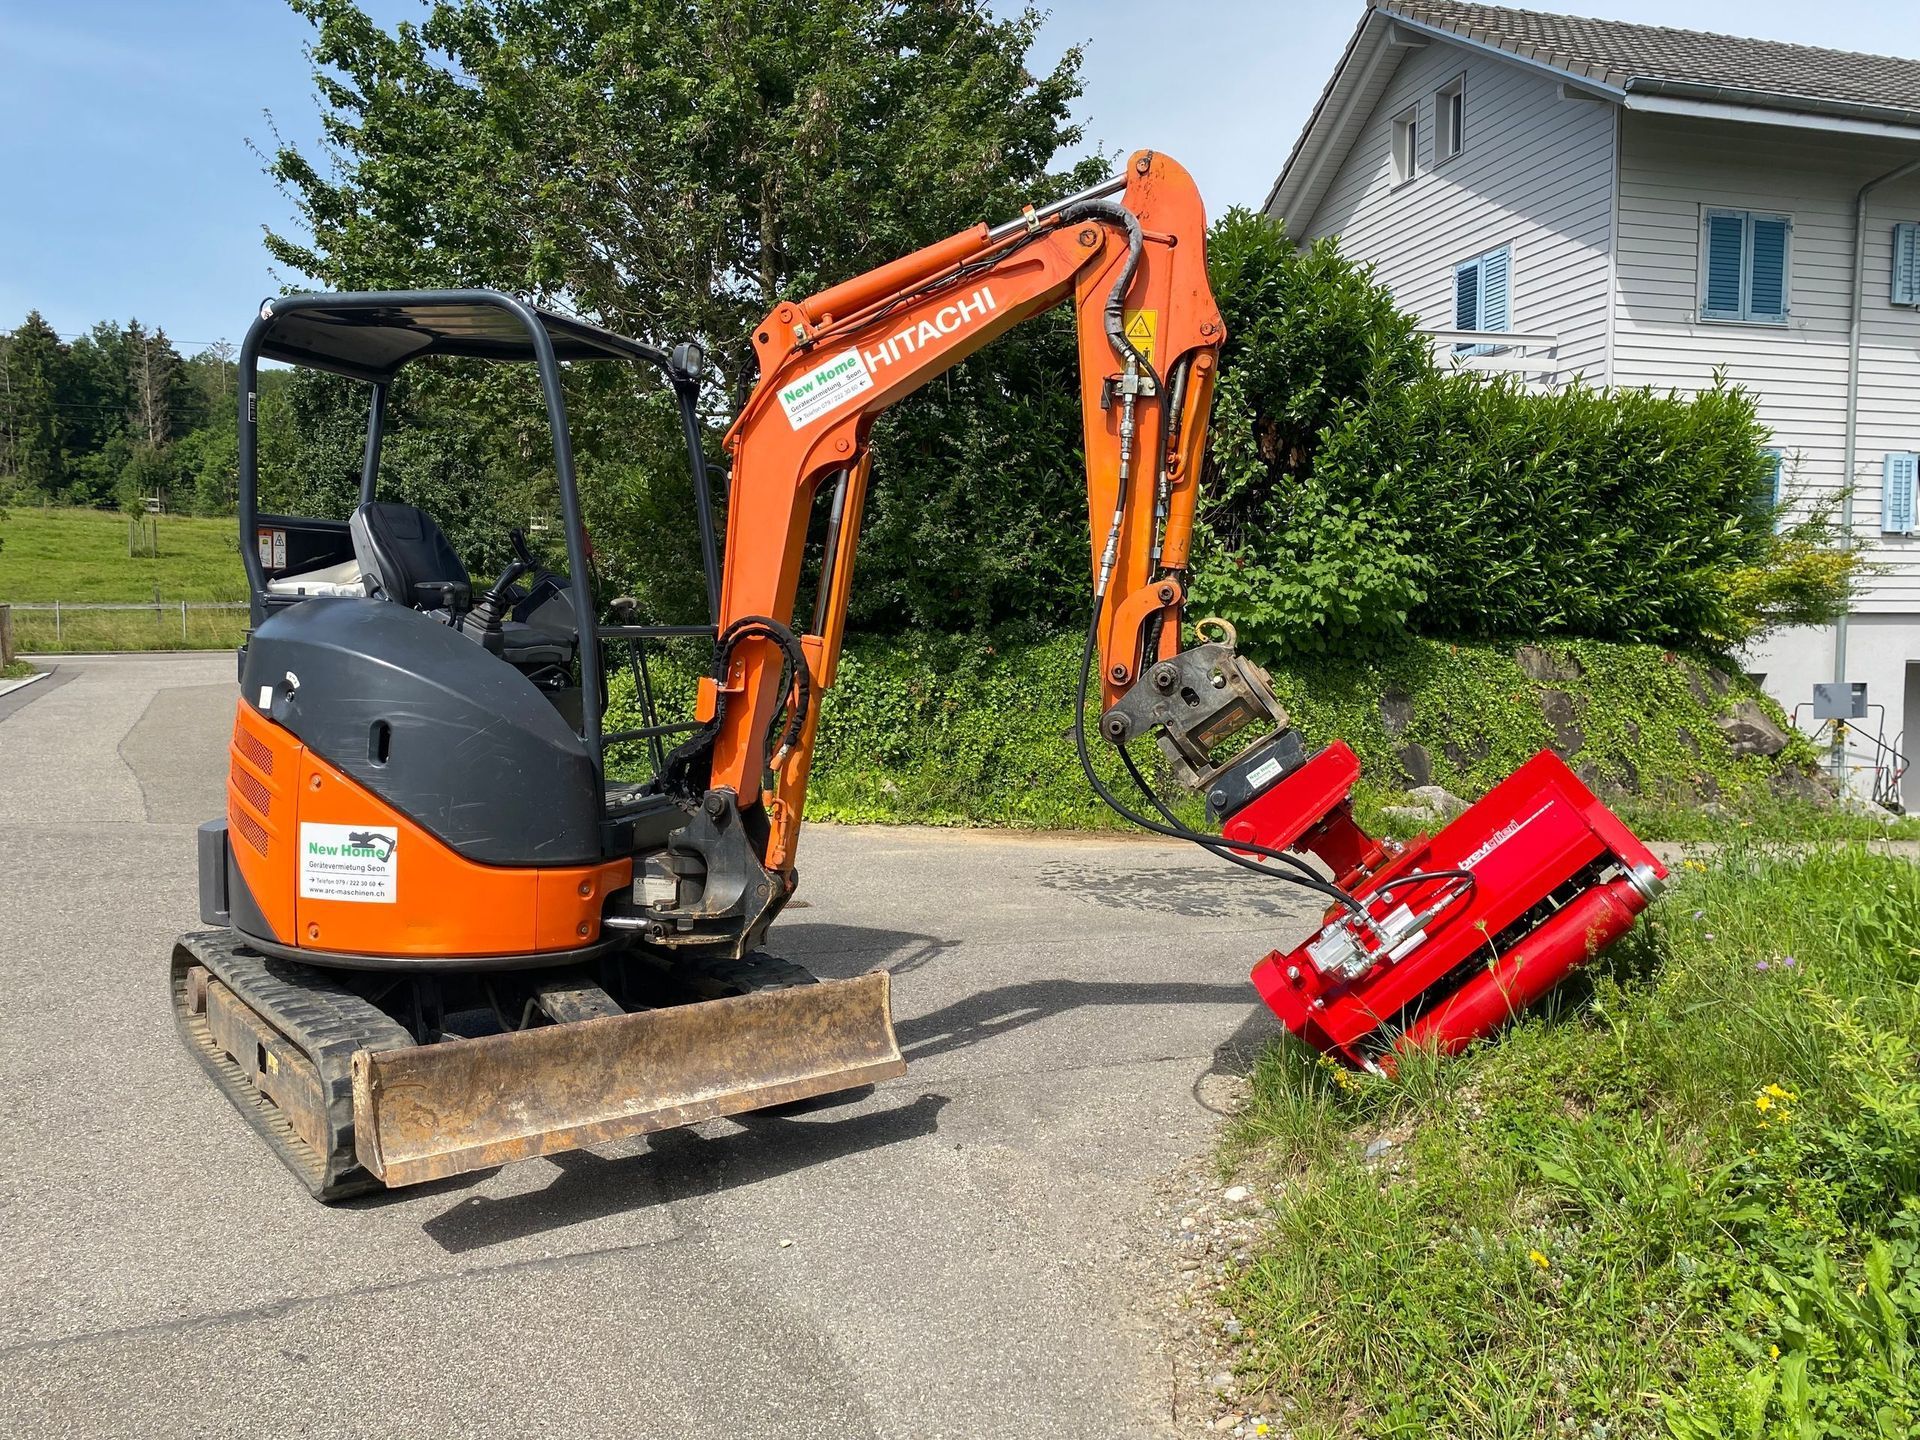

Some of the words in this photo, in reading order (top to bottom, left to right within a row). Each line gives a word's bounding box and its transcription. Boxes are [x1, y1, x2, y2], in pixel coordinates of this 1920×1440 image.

[864, 286, 996, 373] HITACHI
[784, 382, 813, 404] New
[815, 358, 856, 385] Home
[791, 381, 841, 412] Gerätevermietung
[846, 369, 861, 380] Seon
[804, 407, 821, 418] Telefon
[834, 393, 844, 401] 222
[309, 843, 337, 855] New
[341, 844, 385, 857] Home
[309, 861, 365, 872] Gerätevermietung
[309, 887, 385, 897] www.arc-maschinen.ch
